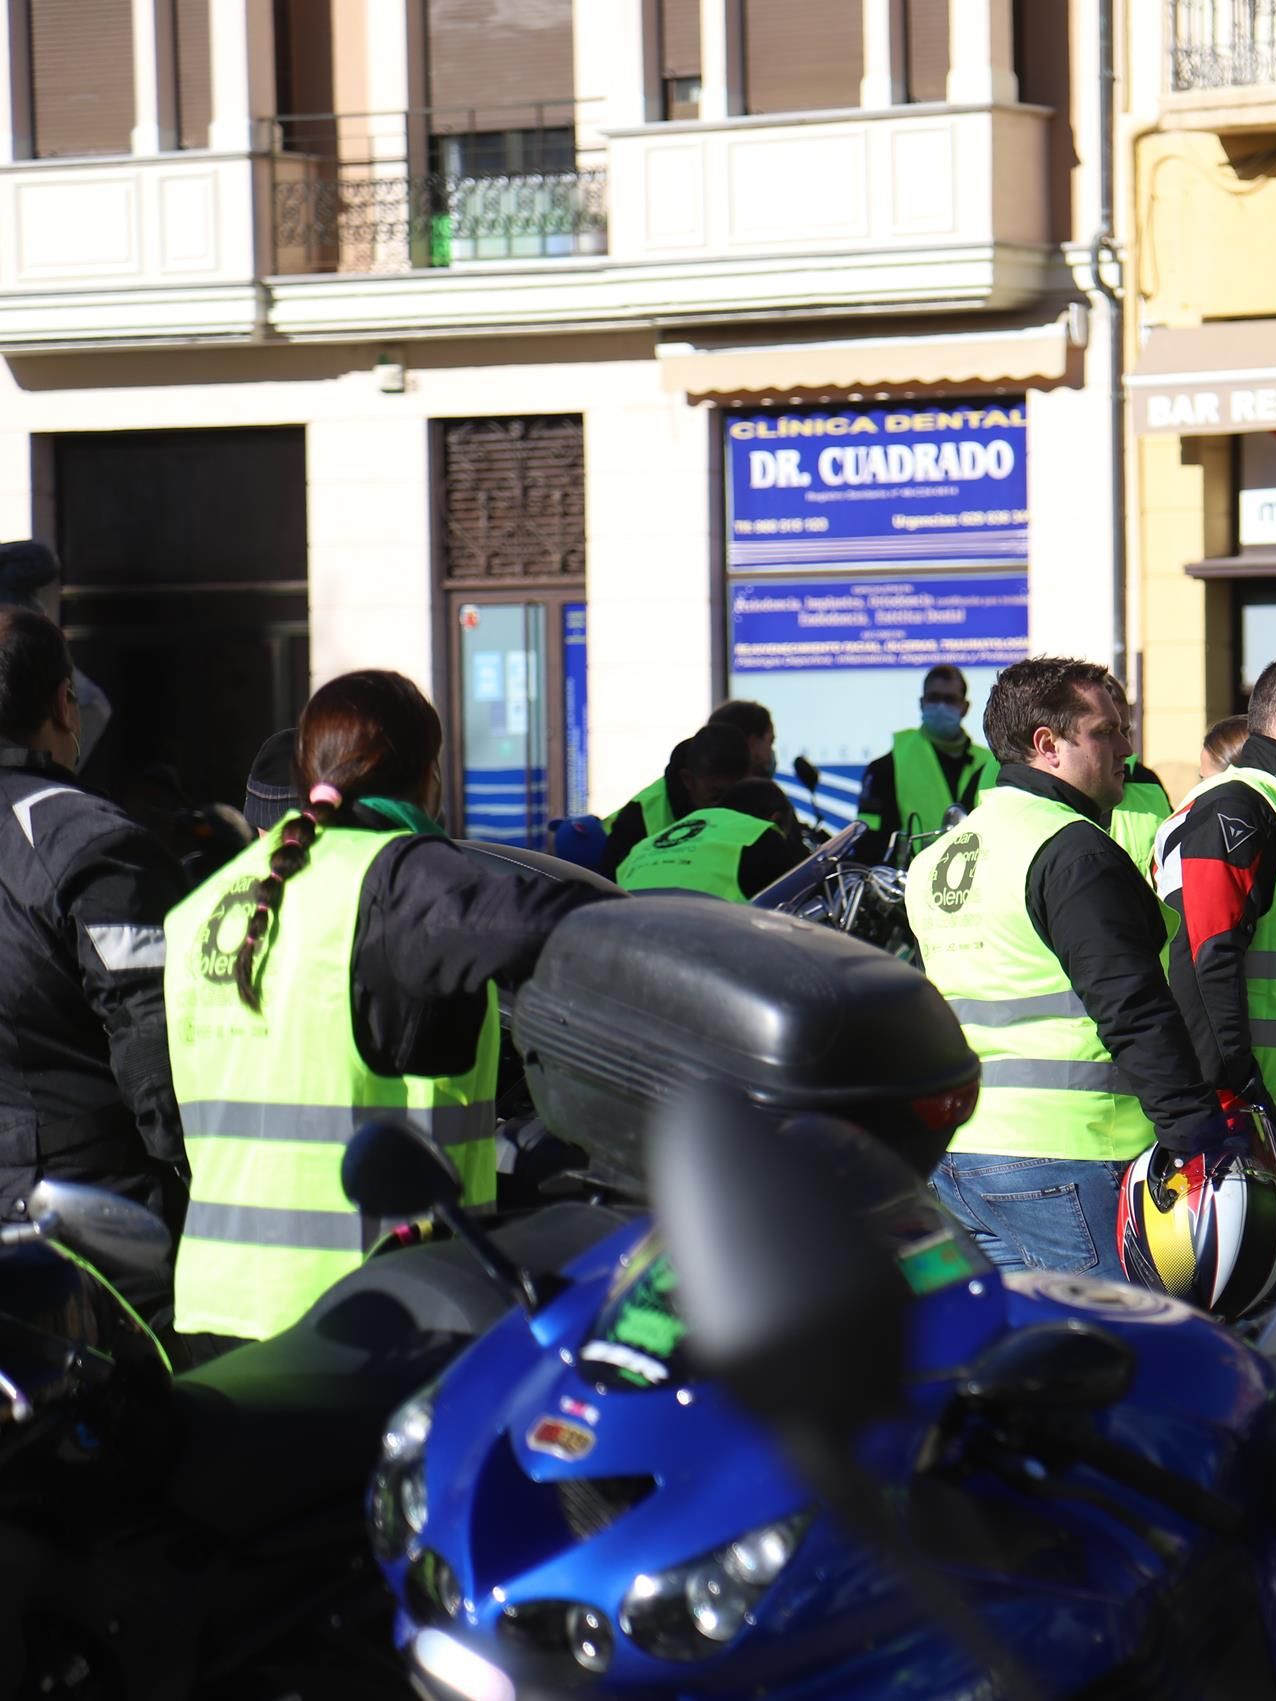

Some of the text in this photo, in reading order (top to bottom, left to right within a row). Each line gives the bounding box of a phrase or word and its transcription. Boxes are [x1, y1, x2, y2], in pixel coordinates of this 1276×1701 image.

[729, 410, 1027, 440] CLÍNICA DENTAL
[1147, 392, 1220, 427] BAR
[750, 439, 1015, 489] DR. CUADRADO
